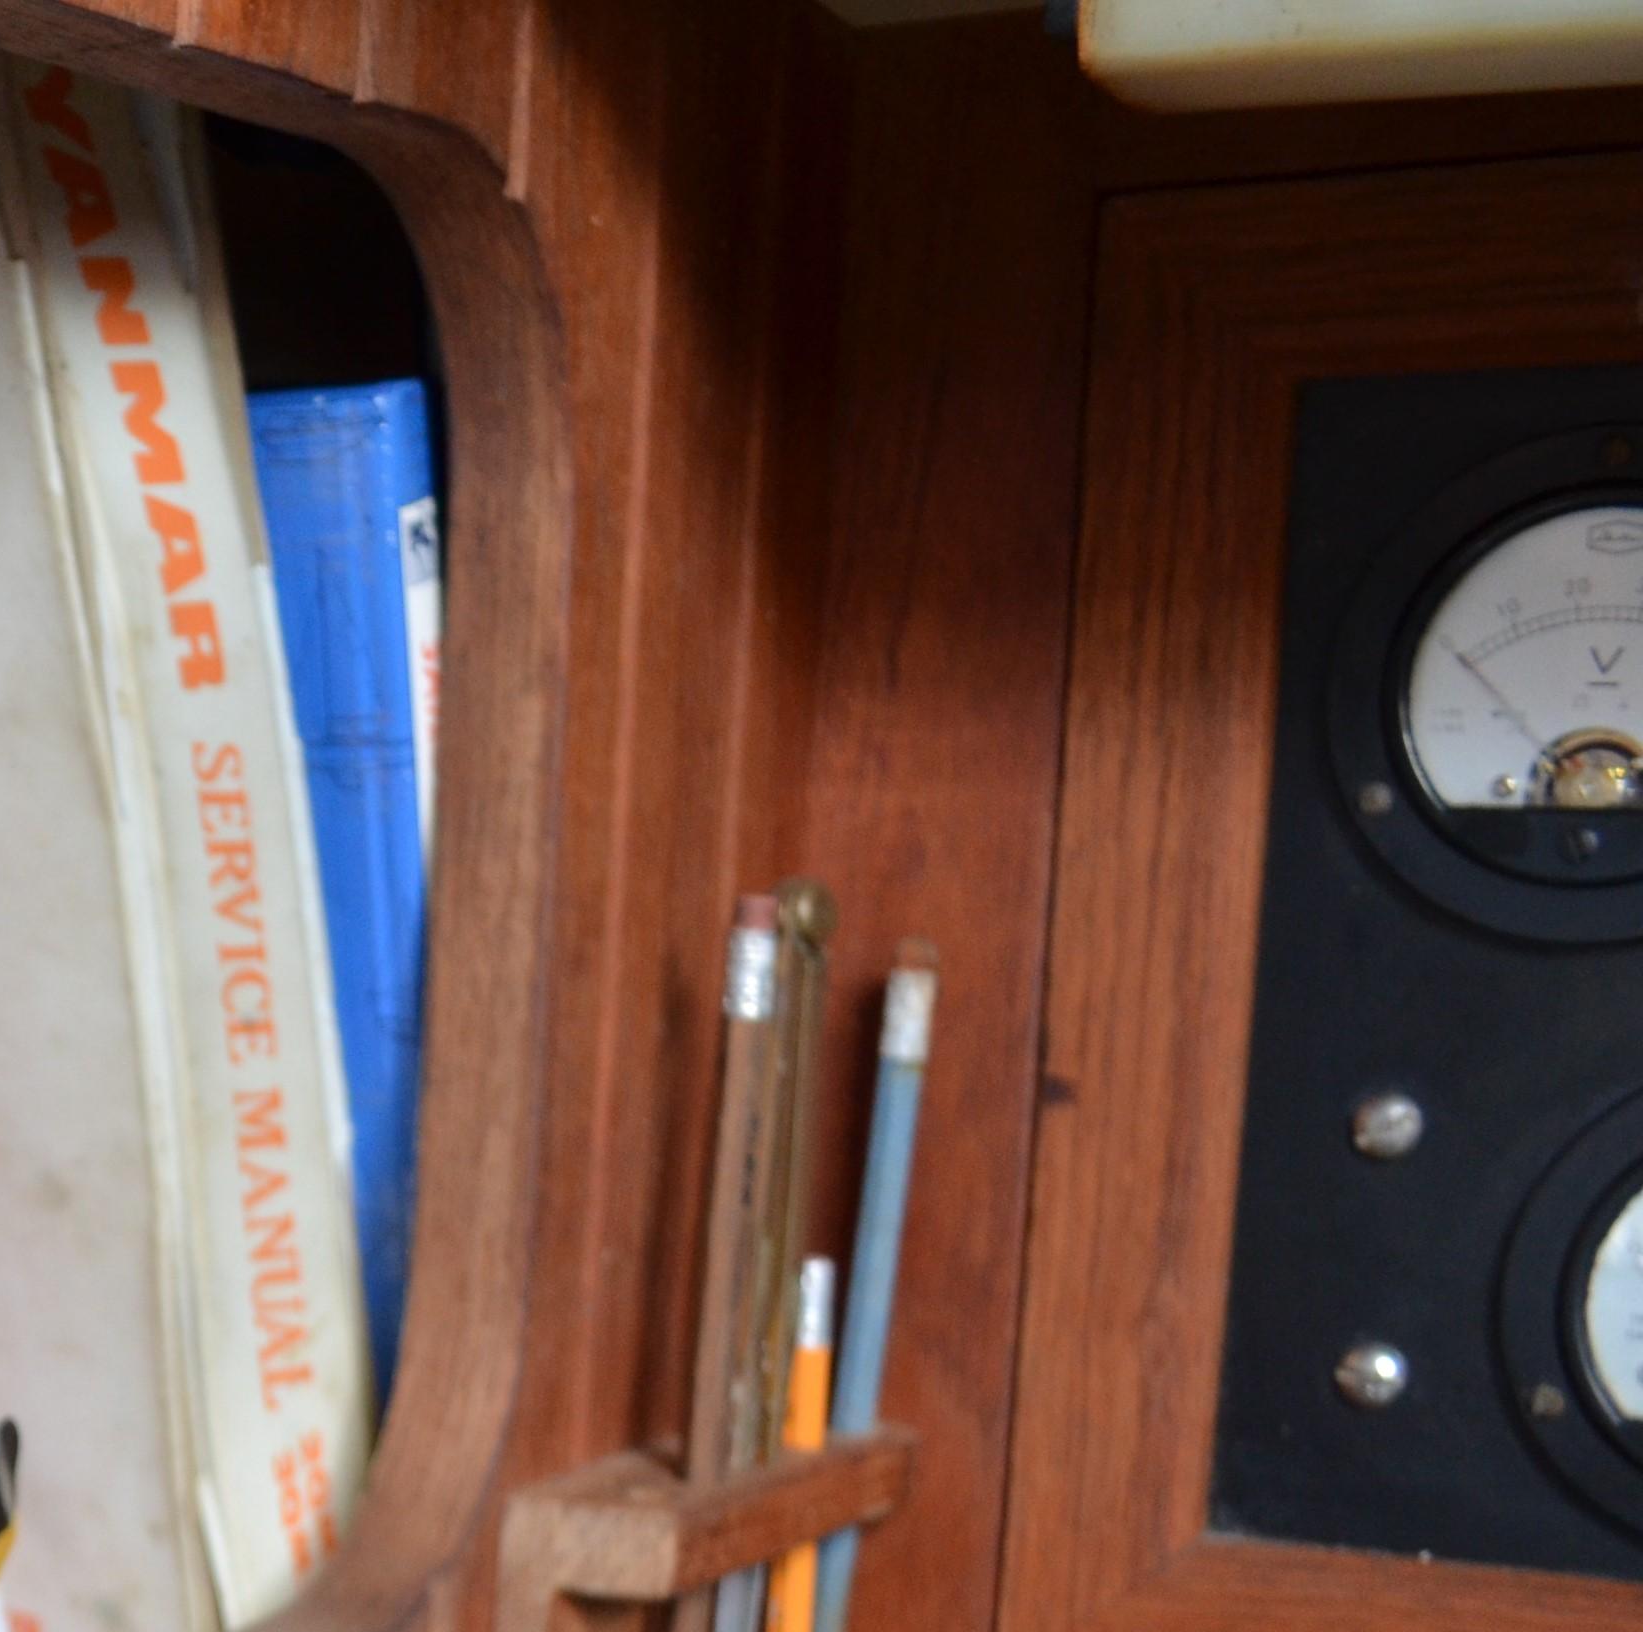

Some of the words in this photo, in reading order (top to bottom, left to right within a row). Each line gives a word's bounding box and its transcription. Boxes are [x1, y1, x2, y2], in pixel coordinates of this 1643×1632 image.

[23, 64, 227, 692] YANMAR
[187, 736, 283, 1067] SERVICE
[231, 1086, 317, 1413] MANUAL
